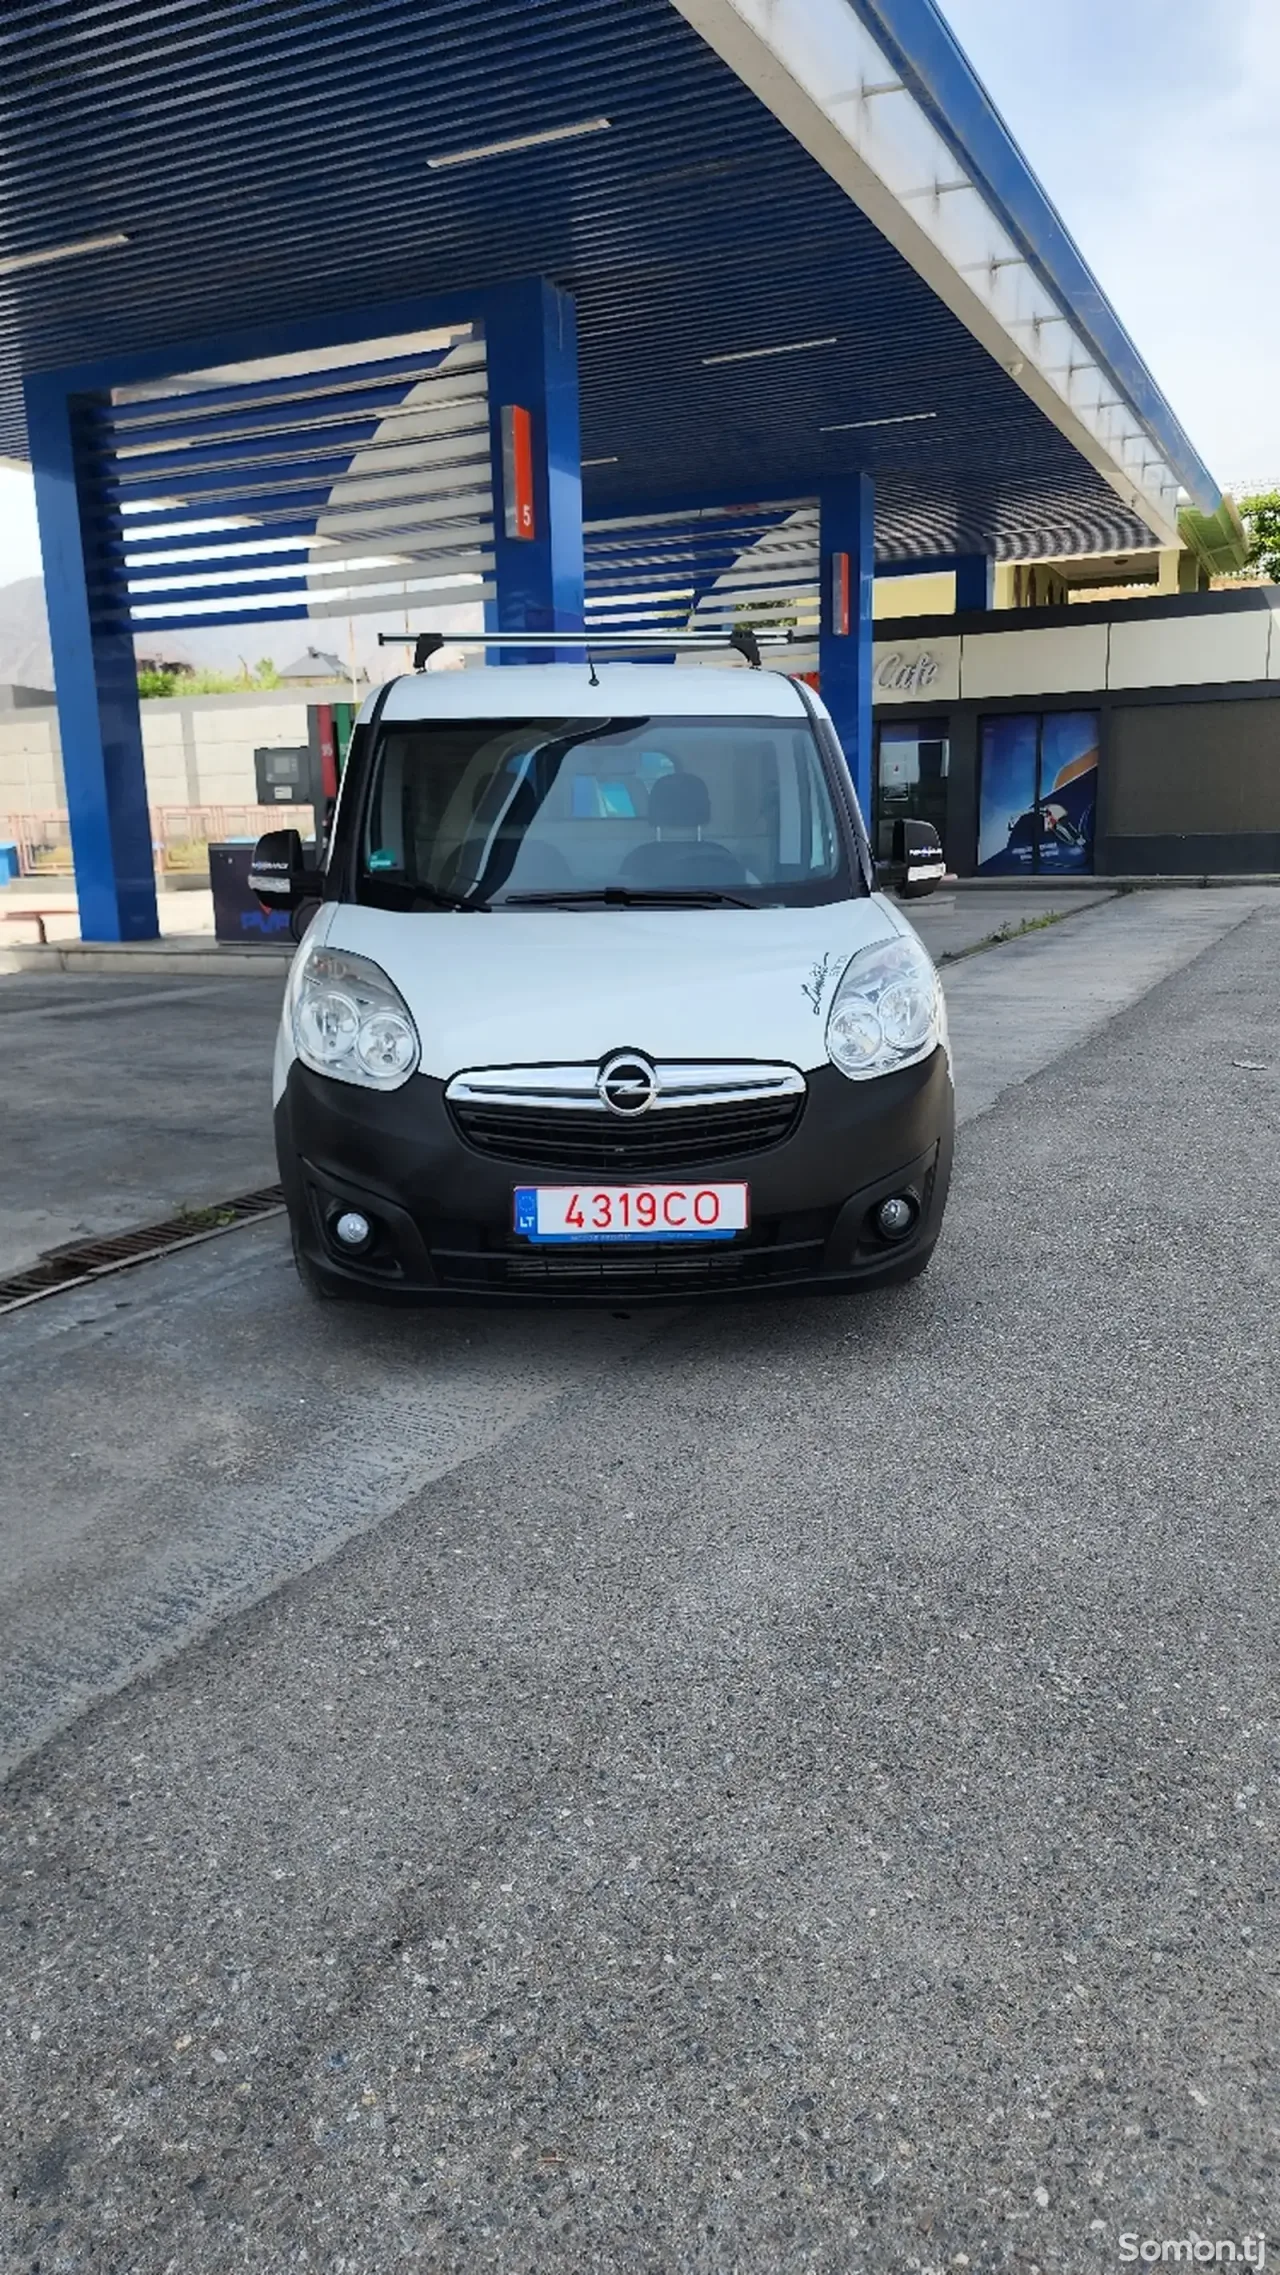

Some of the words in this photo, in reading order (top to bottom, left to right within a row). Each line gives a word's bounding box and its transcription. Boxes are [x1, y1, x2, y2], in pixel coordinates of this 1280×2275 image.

[523, 504, 531, 526] 5
[873, 652, 939, 697] Cafe
[519, 1216, 535, 1228] LT
[564, 1190, 720, 1228] 4319CO
